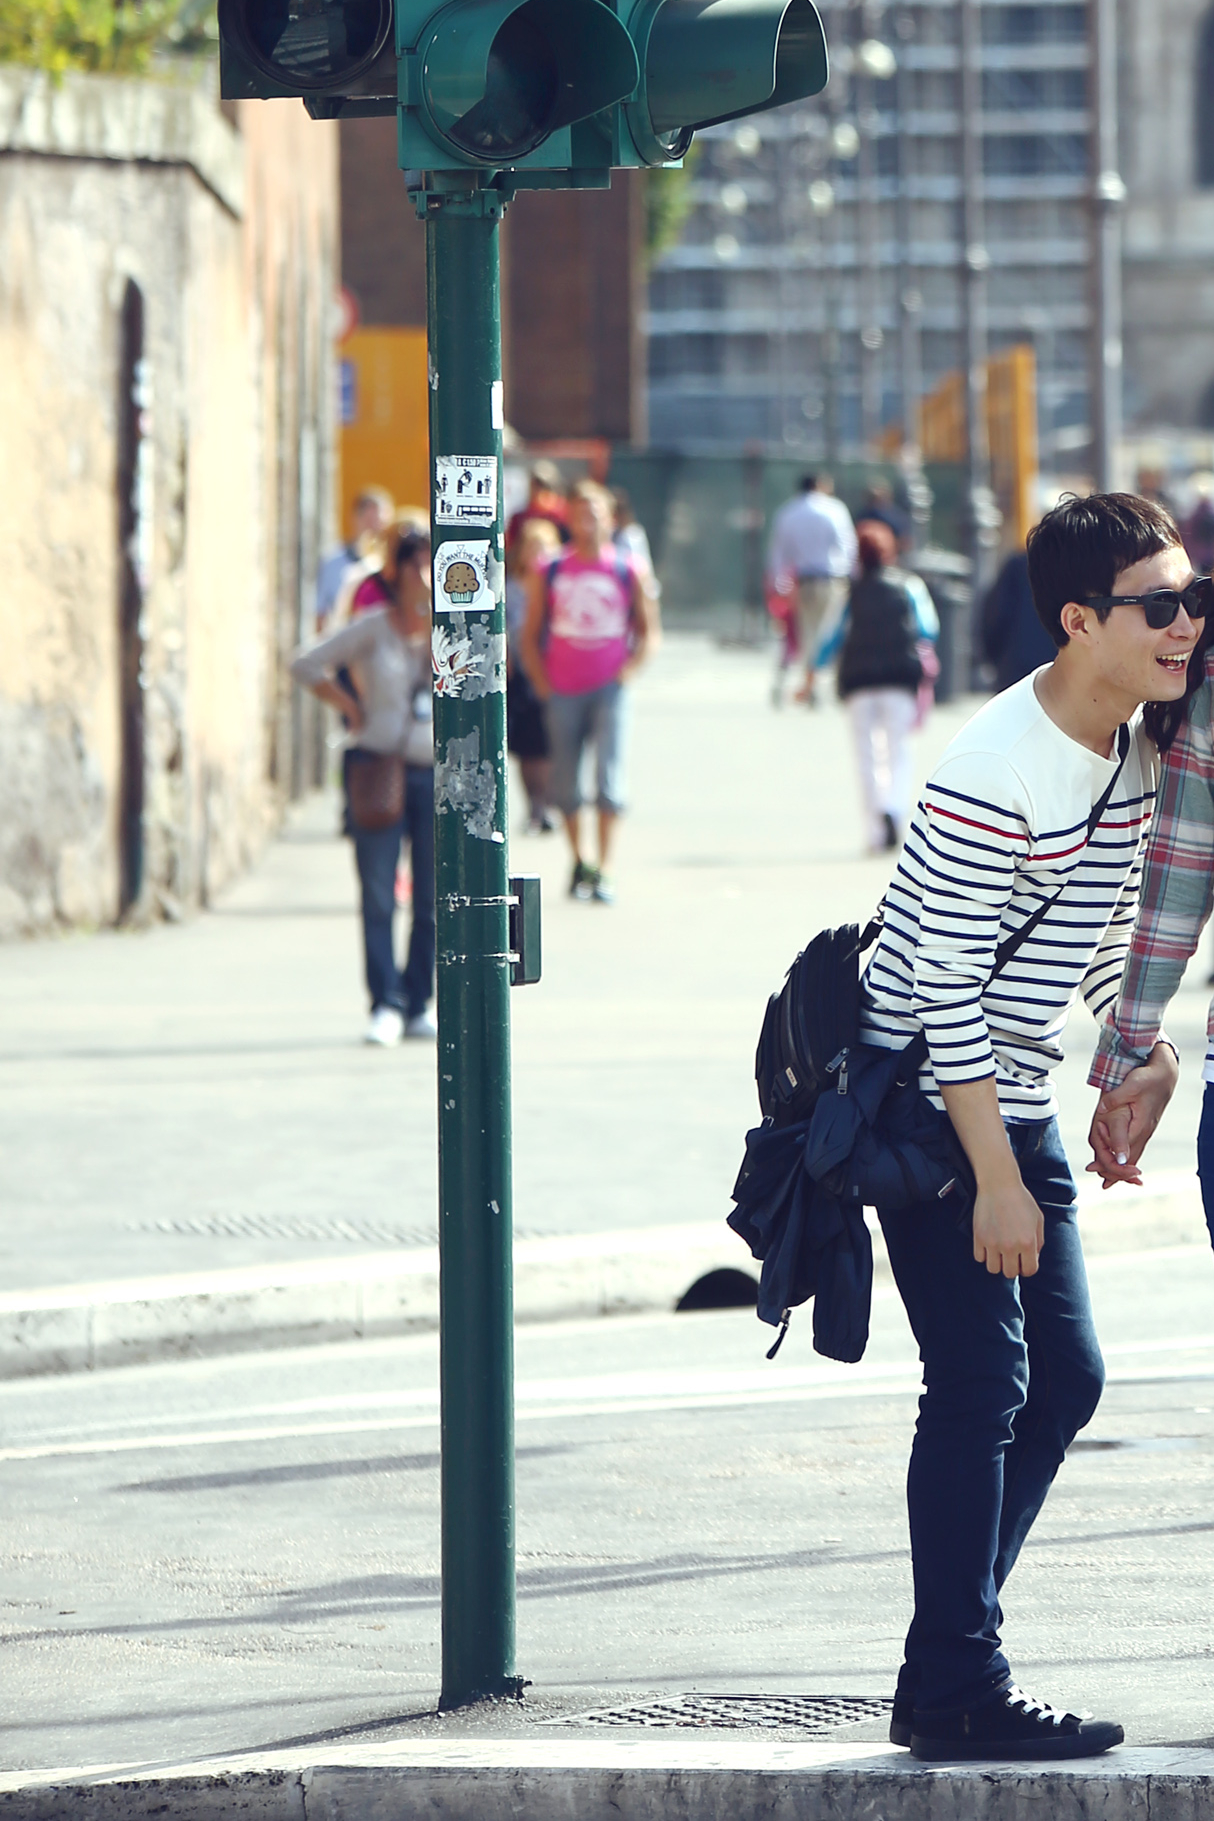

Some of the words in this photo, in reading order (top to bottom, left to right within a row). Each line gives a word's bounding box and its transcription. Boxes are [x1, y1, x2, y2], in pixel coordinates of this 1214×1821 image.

[439, 559, 447, 572] YOU
[446, 552, 461, 562] WANT
[463, 552, 474, 561] THE
